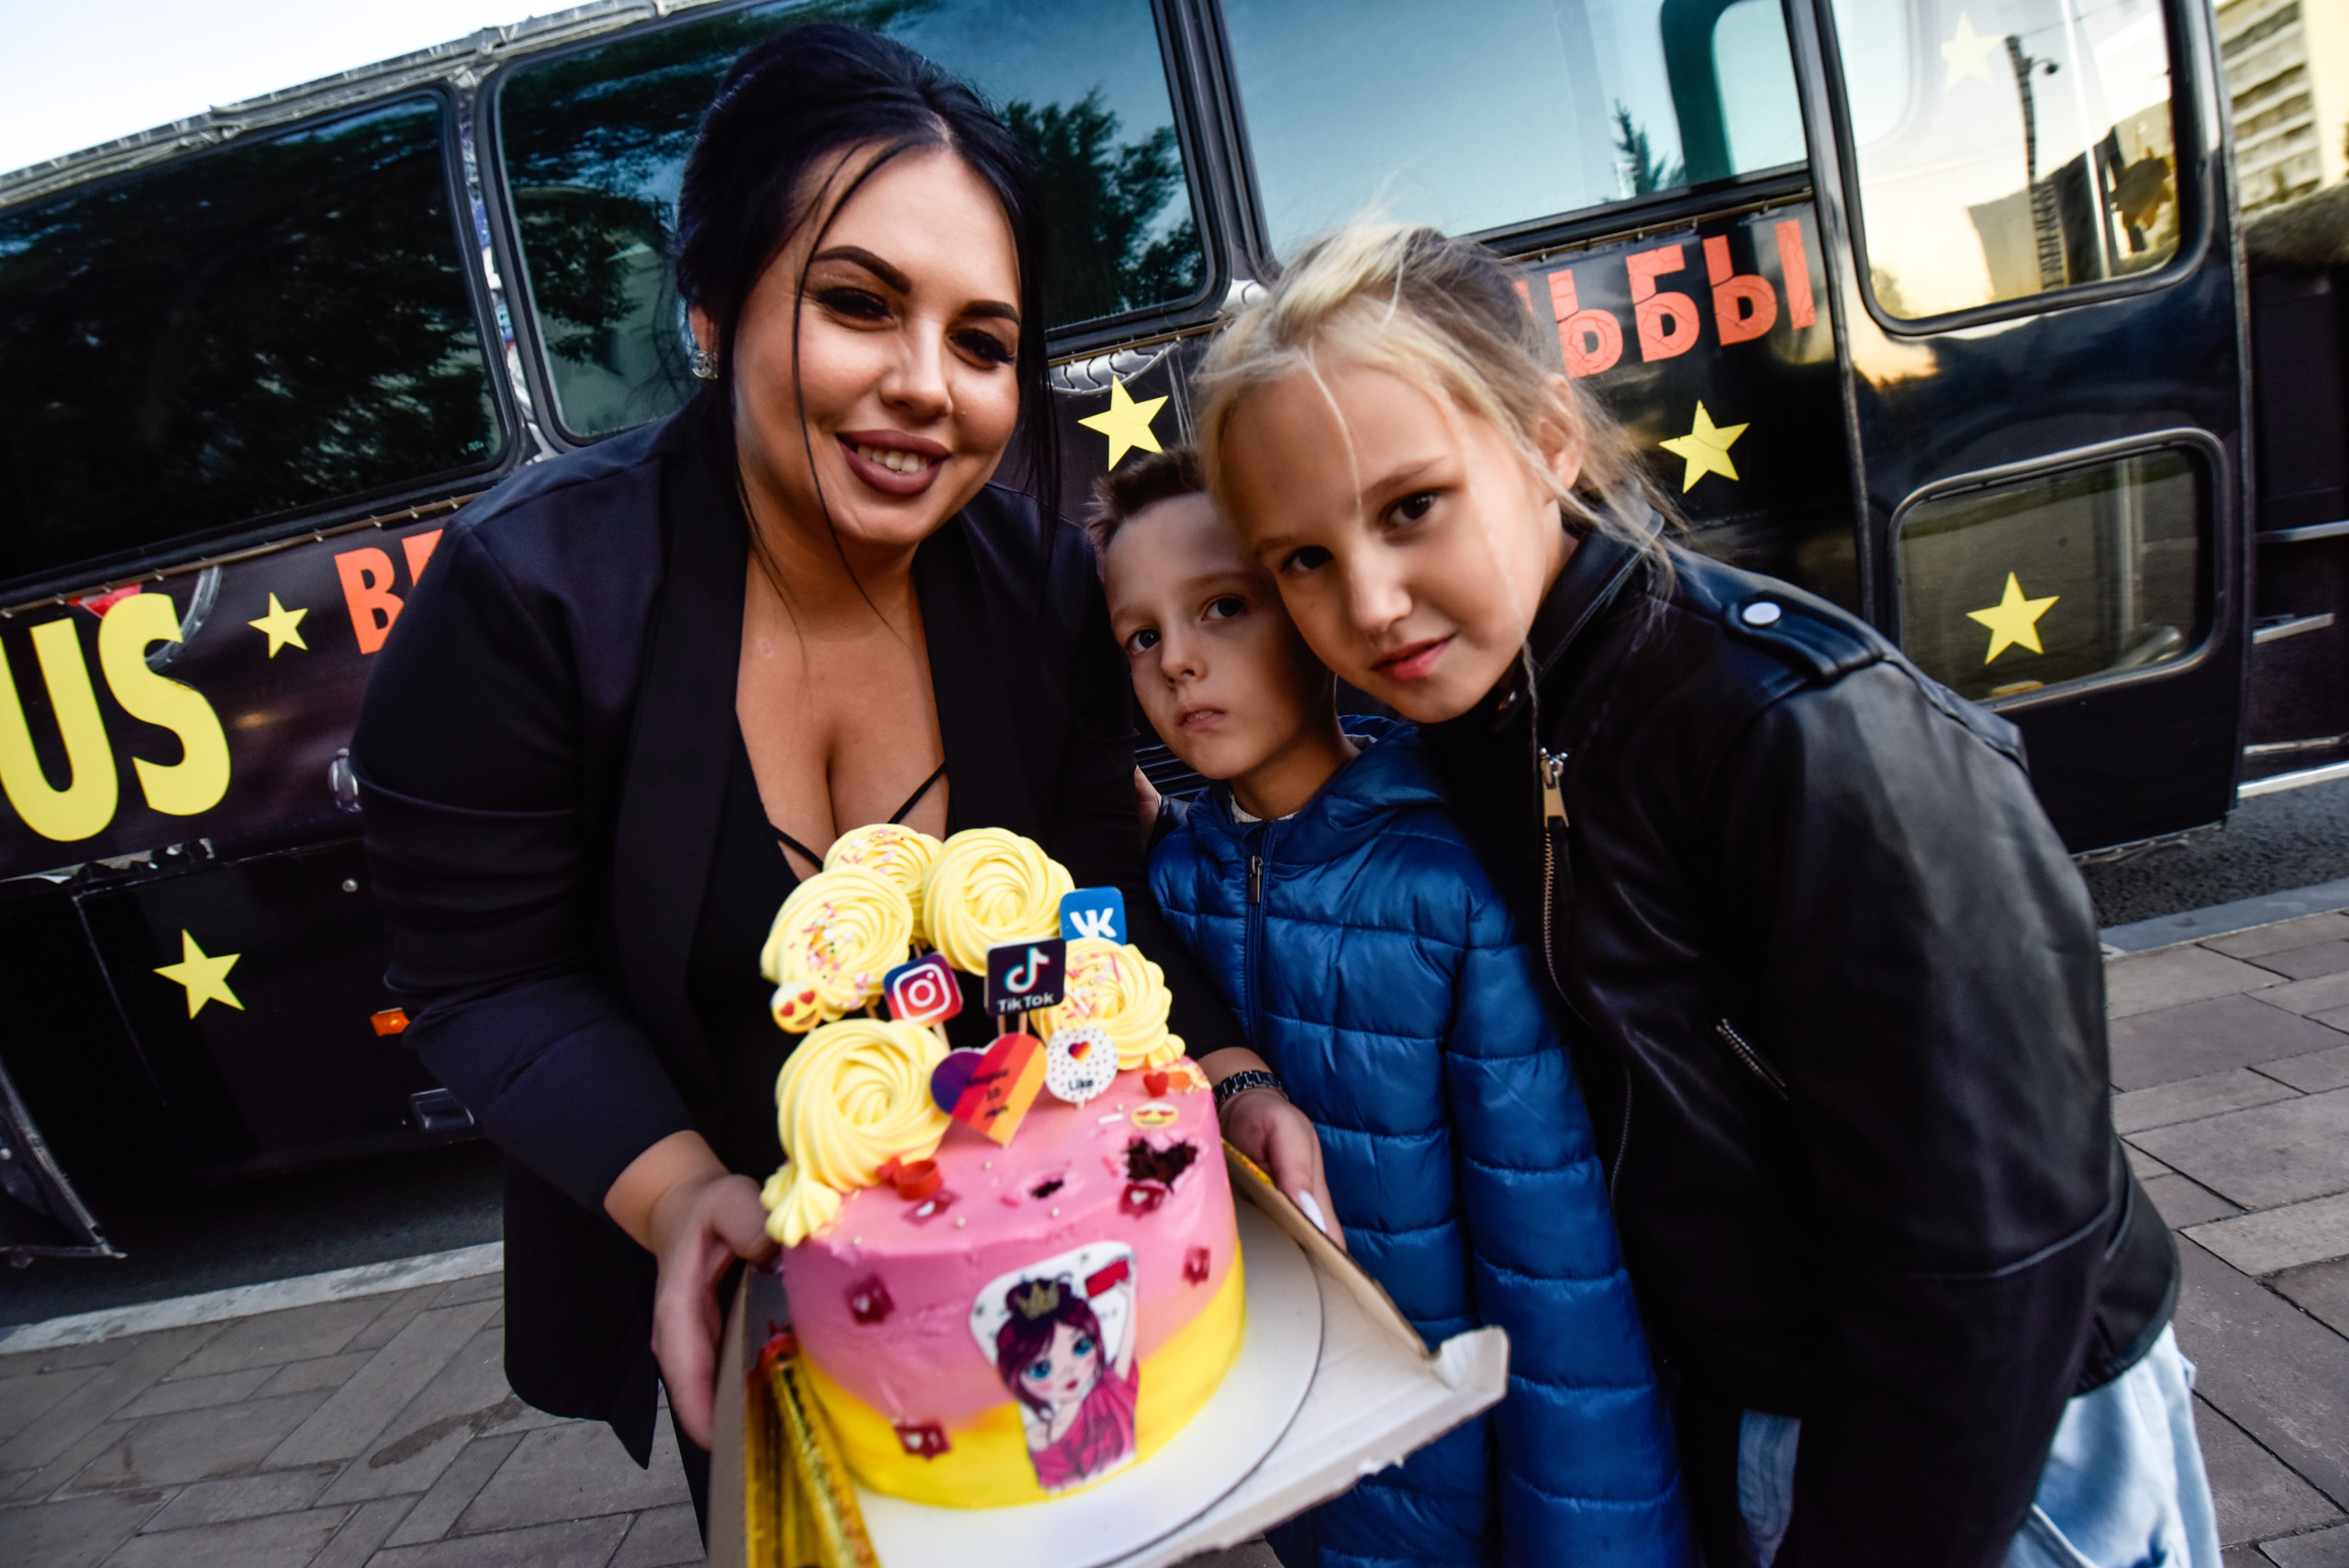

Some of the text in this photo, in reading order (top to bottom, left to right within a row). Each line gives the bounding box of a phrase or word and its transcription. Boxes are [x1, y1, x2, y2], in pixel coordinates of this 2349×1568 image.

[1511, 218, 1817, 379] ЬБЫ
[1069, 907, 1117, 938] VK
[996, 992, 1054, 1013] TikTok
